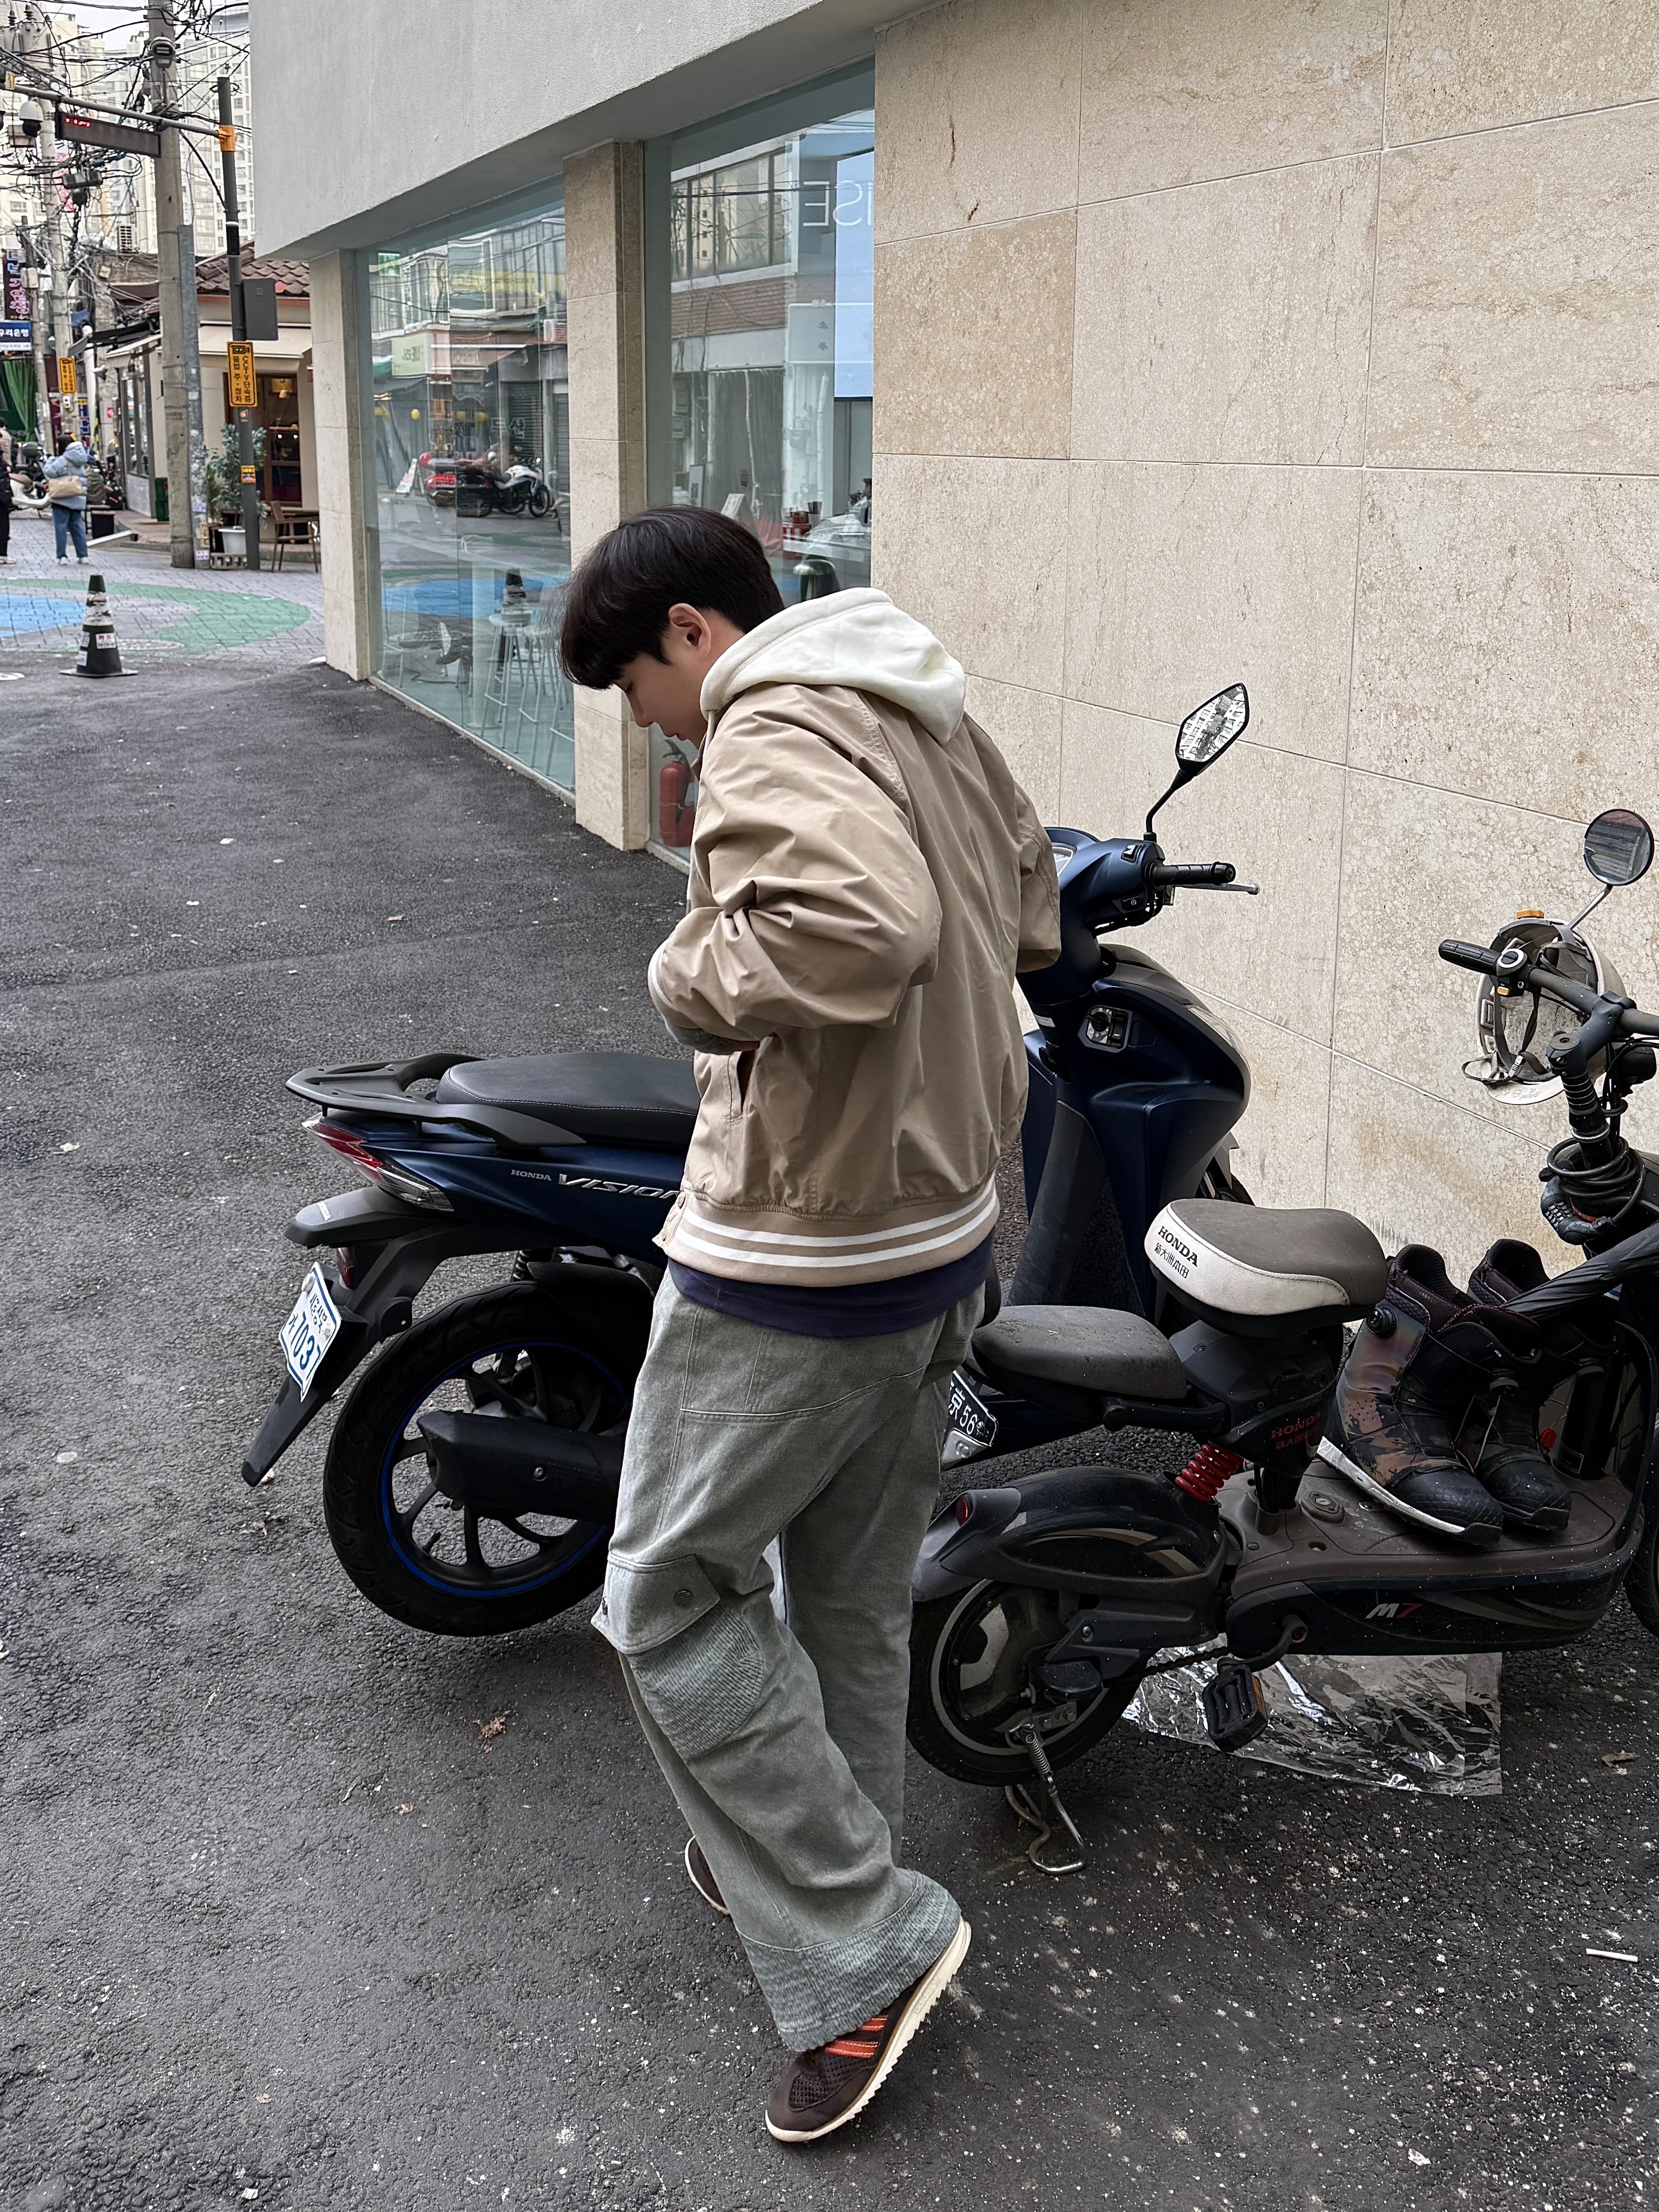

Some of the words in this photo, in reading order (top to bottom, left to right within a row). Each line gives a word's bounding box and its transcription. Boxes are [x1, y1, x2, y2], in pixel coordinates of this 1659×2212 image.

[511, 1169, 552, 1181] HONDA
[1158, 1225, 1198, 1267] HONDA
[291, 1311, 321, 1380] 7037
[1365, 1603, 1422, 1619] M7
